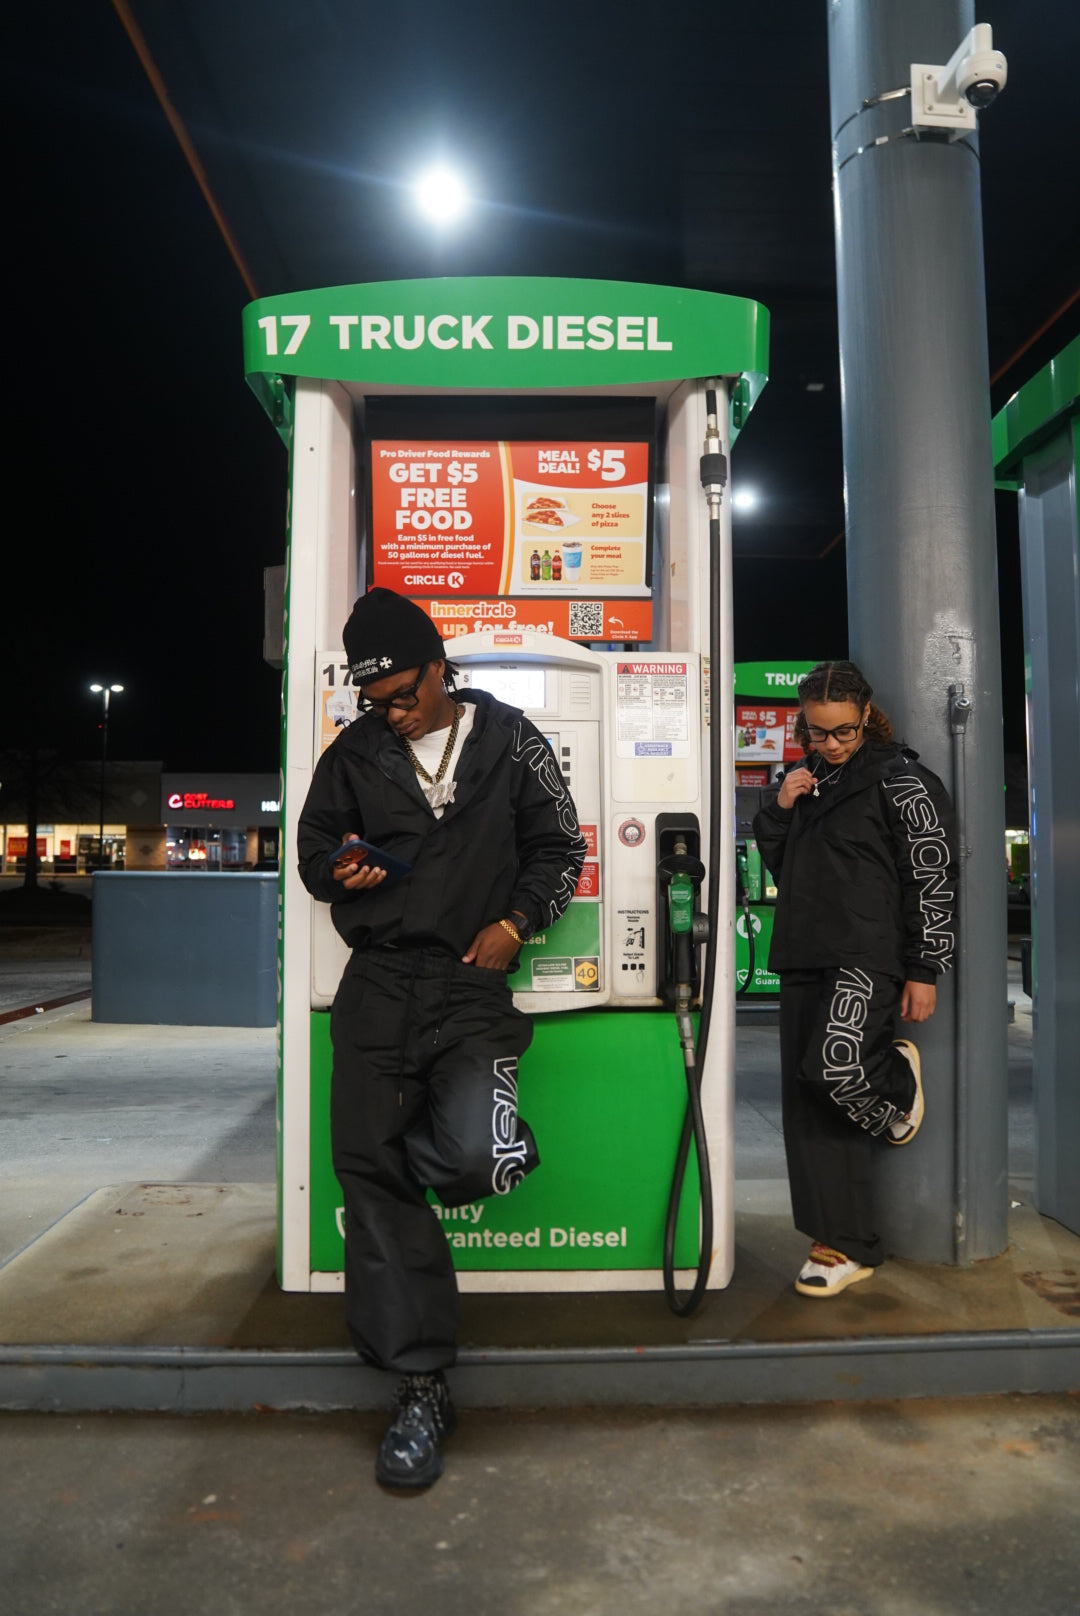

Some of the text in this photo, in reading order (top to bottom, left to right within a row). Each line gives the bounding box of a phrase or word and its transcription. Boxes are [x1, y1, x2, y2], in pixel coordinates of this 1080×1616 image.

[258, 314, 673, 356] 17 TRUCK DIESEL
[380, 450, 490, 458] Pro Driver Food Rewards
[538, 450, 579, 461] MEAL
[538, 462, 580, 474] DEAL!
[587, 448, 626, 482] $5
[389, 461, 478, 485] GET $5
[401, 487, 467, 508] FREE
[395, 509, 473, 530] FOOD
[397, 534, 474, 542] Earn $5 in free food
[446, 543, 481, 552] purchase
[400, 552, 429, 560] gallons
[404, 572, 464, 588] CIRCLE K
[431, 601, 516, 618] innercircle
[443, 624, 468, 636] up
[322, 664, 352, 686] 17
[632, 664, 683, 674] WARNING
[765, 673, 808, 686] TRUC
[759, 711, 776, 726] $5
[184, 800, 234, 809] CUTTERS
[577, 968, 596, 978] 40
[430, 1204, 484, 1224] ality
[445, 1228, 627, 1248] ranteed Diesel
